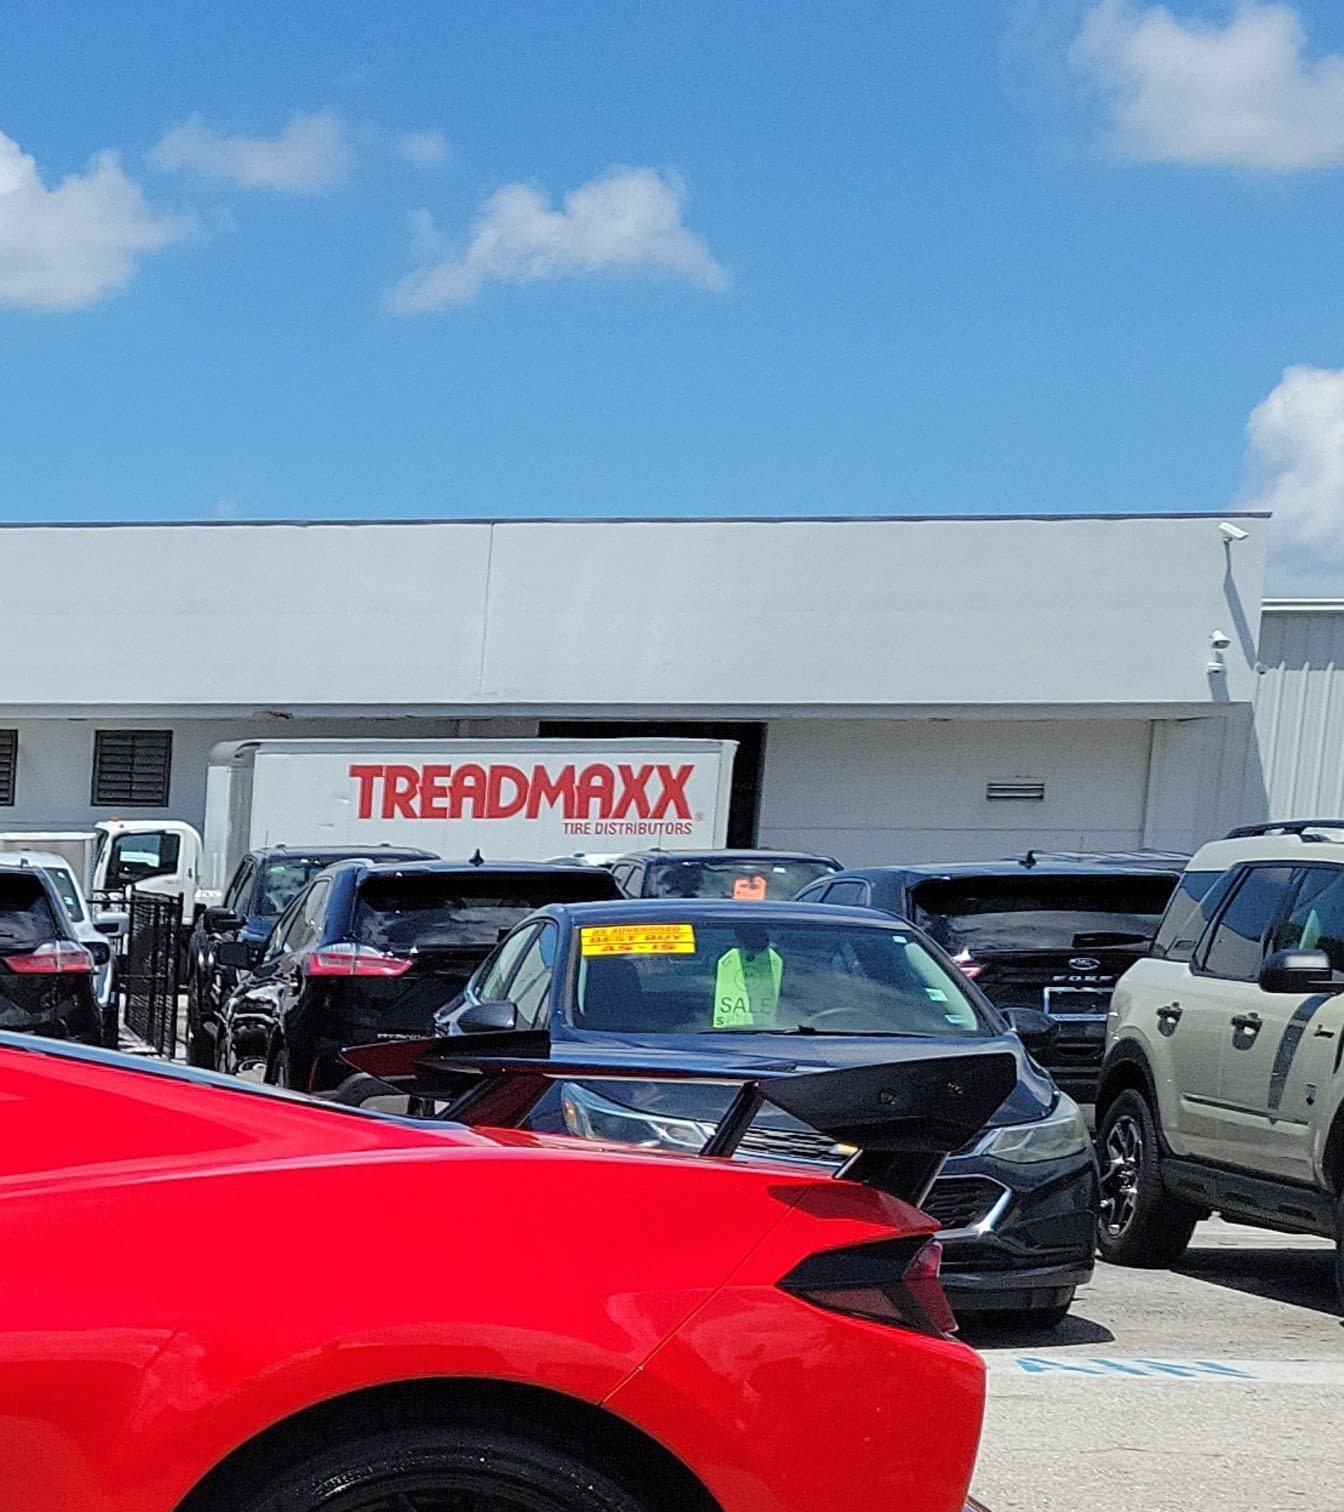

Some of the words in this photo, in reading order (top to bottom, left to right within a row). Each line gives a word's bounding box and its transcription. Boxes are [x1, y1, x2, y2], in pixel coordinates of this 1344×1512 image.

[348, 763, 696, 820] TREADMAXX
[563, 822, 591, 835] TIRE
[595, 822, 693, 835] DISTRIBUTORS
[720, 997, 773, 1014] SALE
